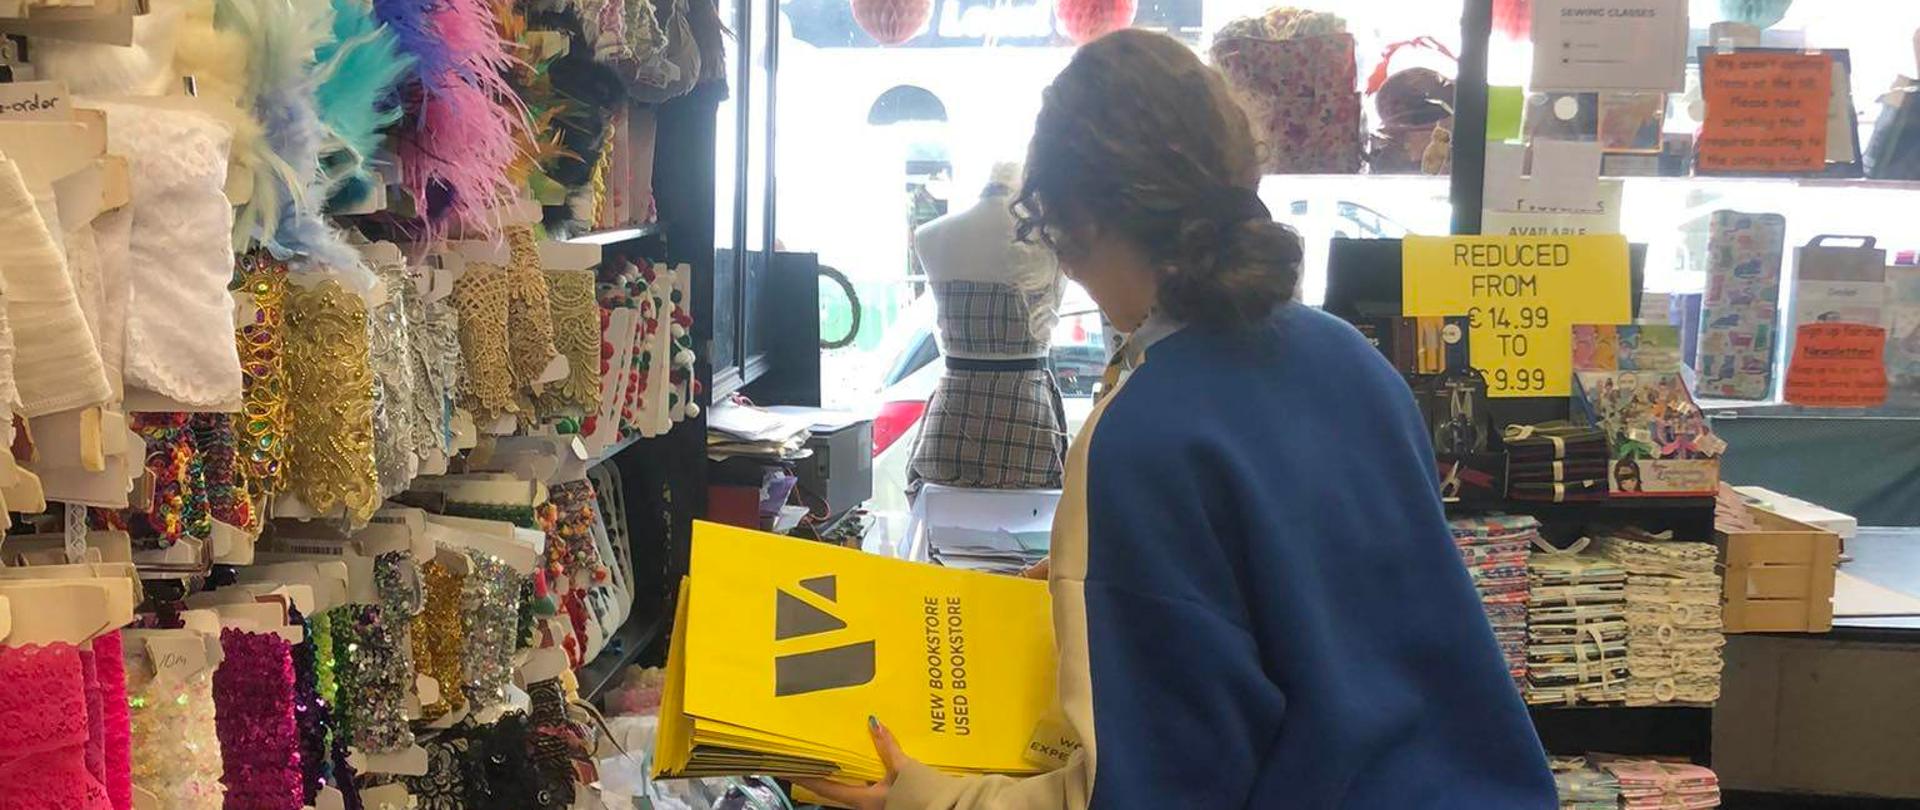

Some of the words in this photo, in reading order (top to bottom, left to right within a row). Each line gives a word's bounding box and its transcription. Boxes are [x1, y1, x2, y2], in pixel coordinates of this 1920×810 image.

[1454, 243, 1569, 267] REDUCED
[1472, 274, 1537, 297] FROM
[1496, 334, 1528, 357] TO
[1481, 368, 1545, 391] 9.99
[924, 596, 944, 690] BOOKSTORE
[946, 596, 967, 690] BOOKSTORE
[930, 693, 946, 733] NEW
[953, 694, 970, 736] USED
